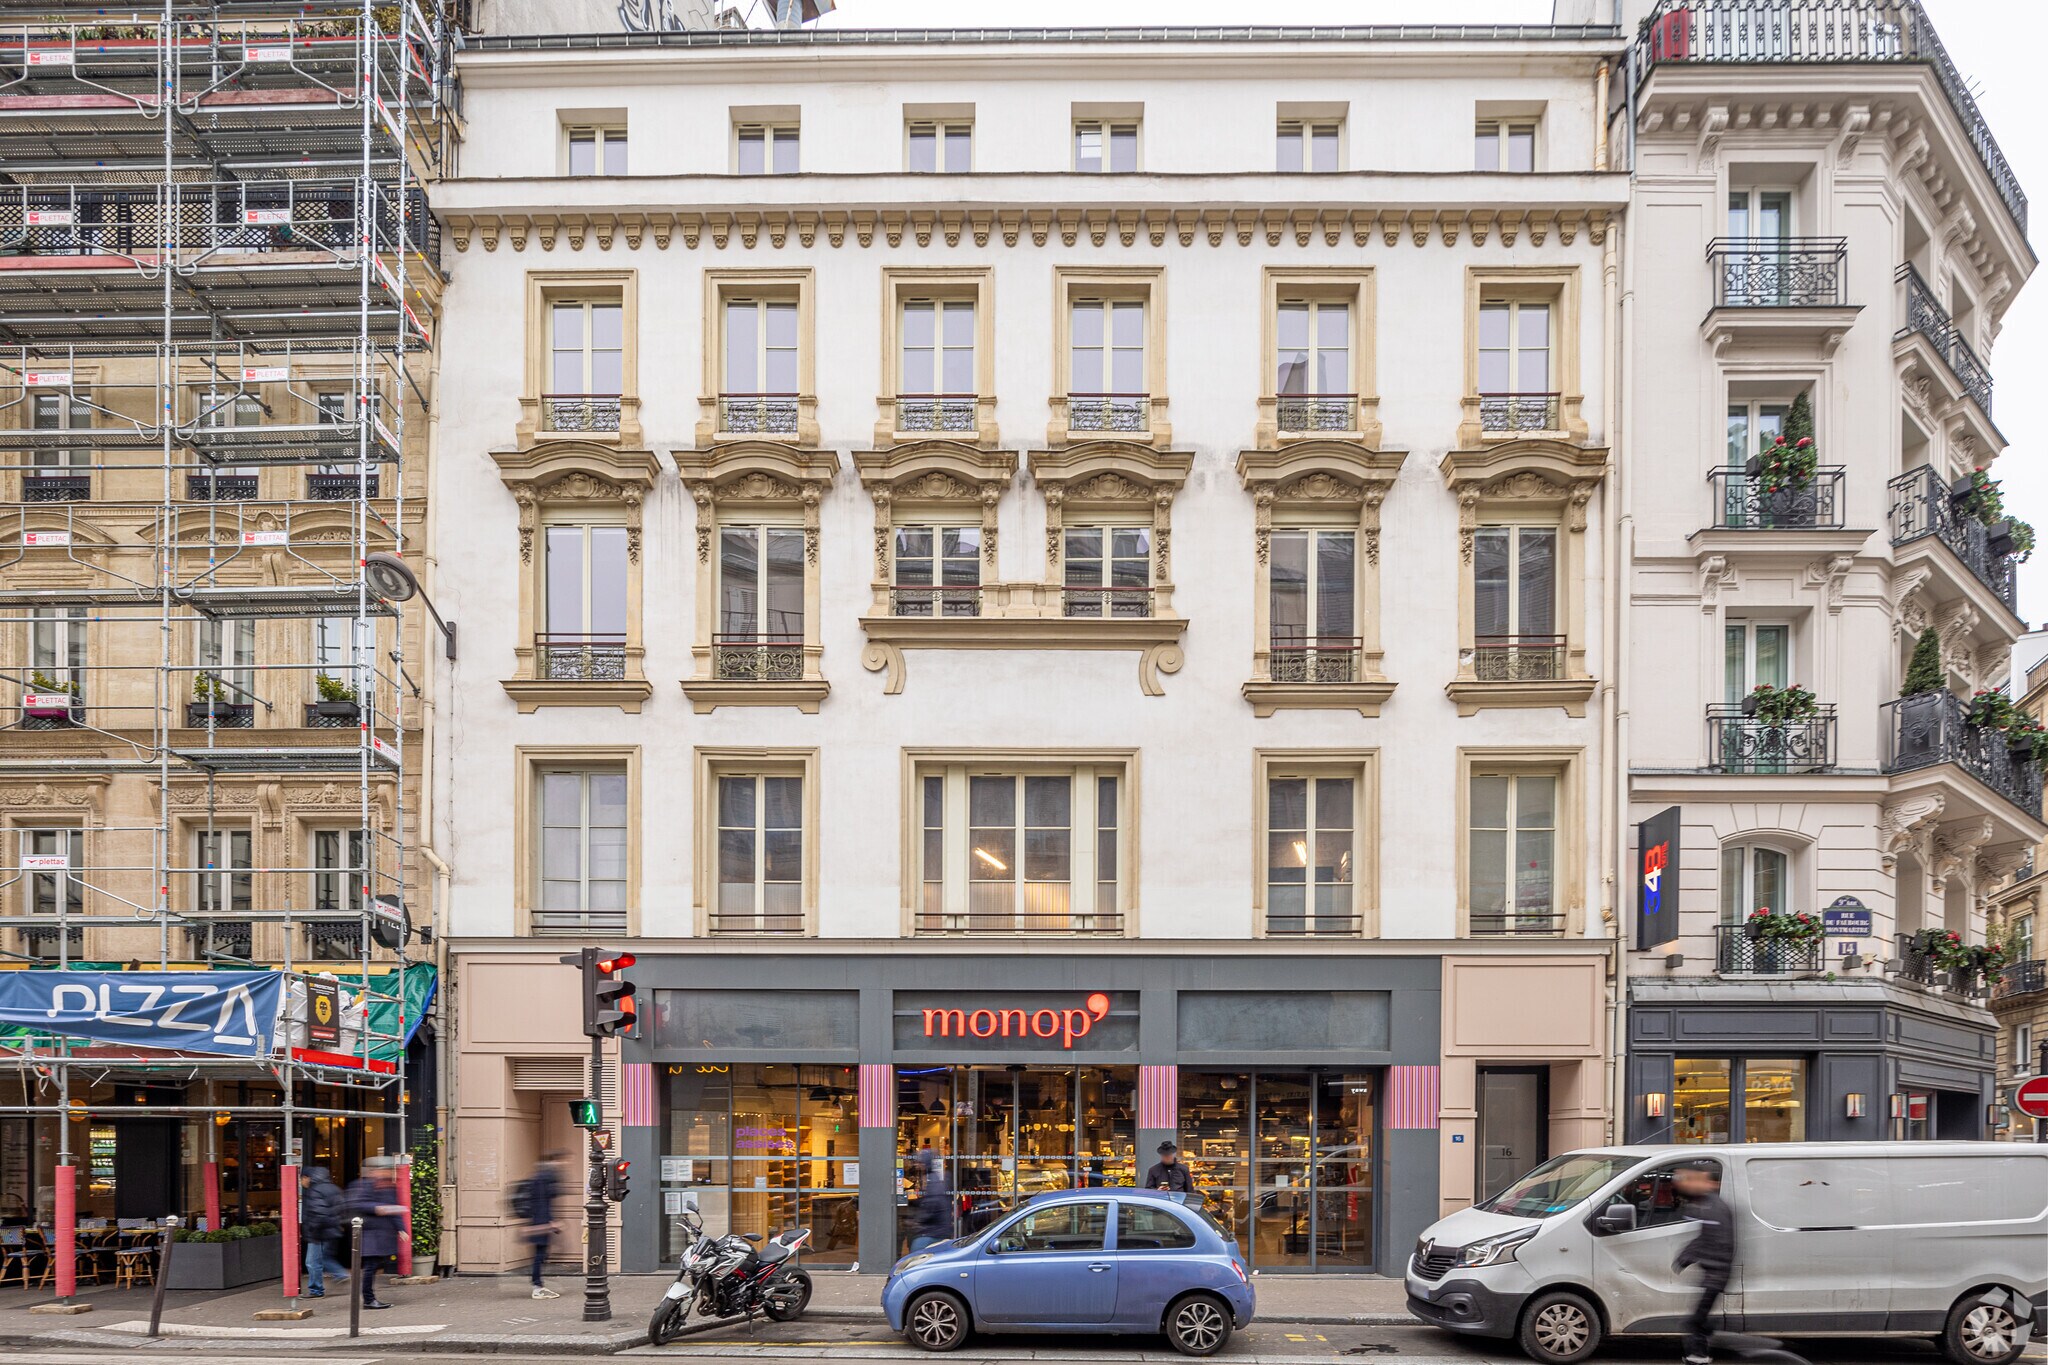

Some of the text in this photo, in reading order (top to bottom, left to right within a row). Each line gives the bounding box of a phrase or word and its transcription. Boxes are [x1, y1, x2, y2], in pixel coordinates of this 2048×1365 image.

[41, 54, 71, 62] PLETTAC
[259, 51, 289, 59] PLETTAC
[40, 213, 70, 222] PLETTAC
[258, 211, 289, 221] PLETTAC
[39, 374, 69, 384] PLETTAC
[256, 370, 286, 379] PLETTAC
[37, 534, 67, 543] PLETTAC
[256, 533, 285, 542] PLETTAC
[37, 695, 67, 705] PLETTAC
[38, 857, 66, 867] plettac
[1841, 942, 1855, 954] 14
[47, 982, 259, 1046] PIZZA
[735, 1126, 787, 1139] places
[735, 1138, 794, 1149] assises
[1501, 1148, 1512, 1157] 16
